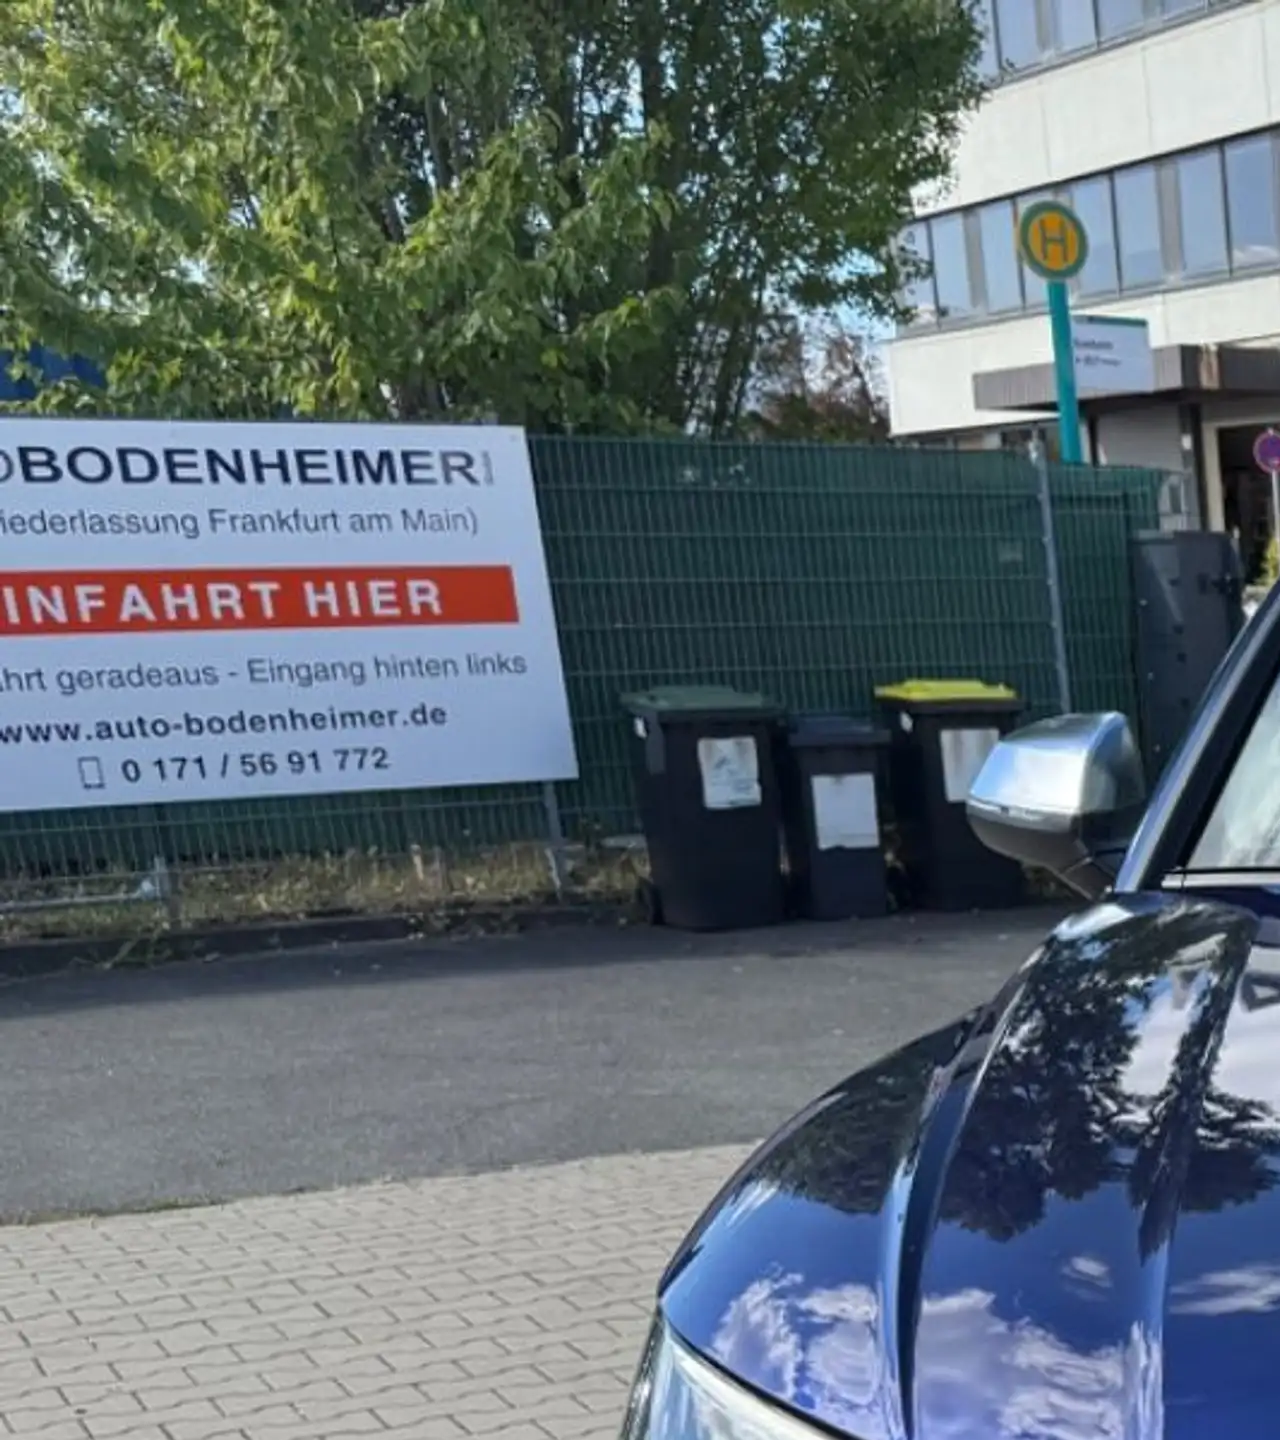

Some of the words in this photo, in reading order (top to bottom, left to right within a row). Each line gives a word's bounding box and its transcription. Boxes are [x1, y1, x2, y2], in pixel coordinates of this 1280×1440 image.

[1039, 219, 1069, 263] H
[209, 509, 338, 533] Frankfurt
[350, 513, 392, 531] am
[401, 506, 478, 535] Main)
[3, 582, 282, 624] INFAHRT
[304, 579, 443, 618] HIER
[0, 668, 46, 692] hrt
[56, 661, 219, 695] geradeaus
[248, 658, 366, 686] Eingang
[375, 655, 458, 678] hinten
[467, 652, 527, 676] links
[0, 703, 447, 743] www.auto-bodenheimer.de
[240, 752, 277, 777] 56
[287, 750, 321, 774] 91
[333, 748, 390, 771] 772
